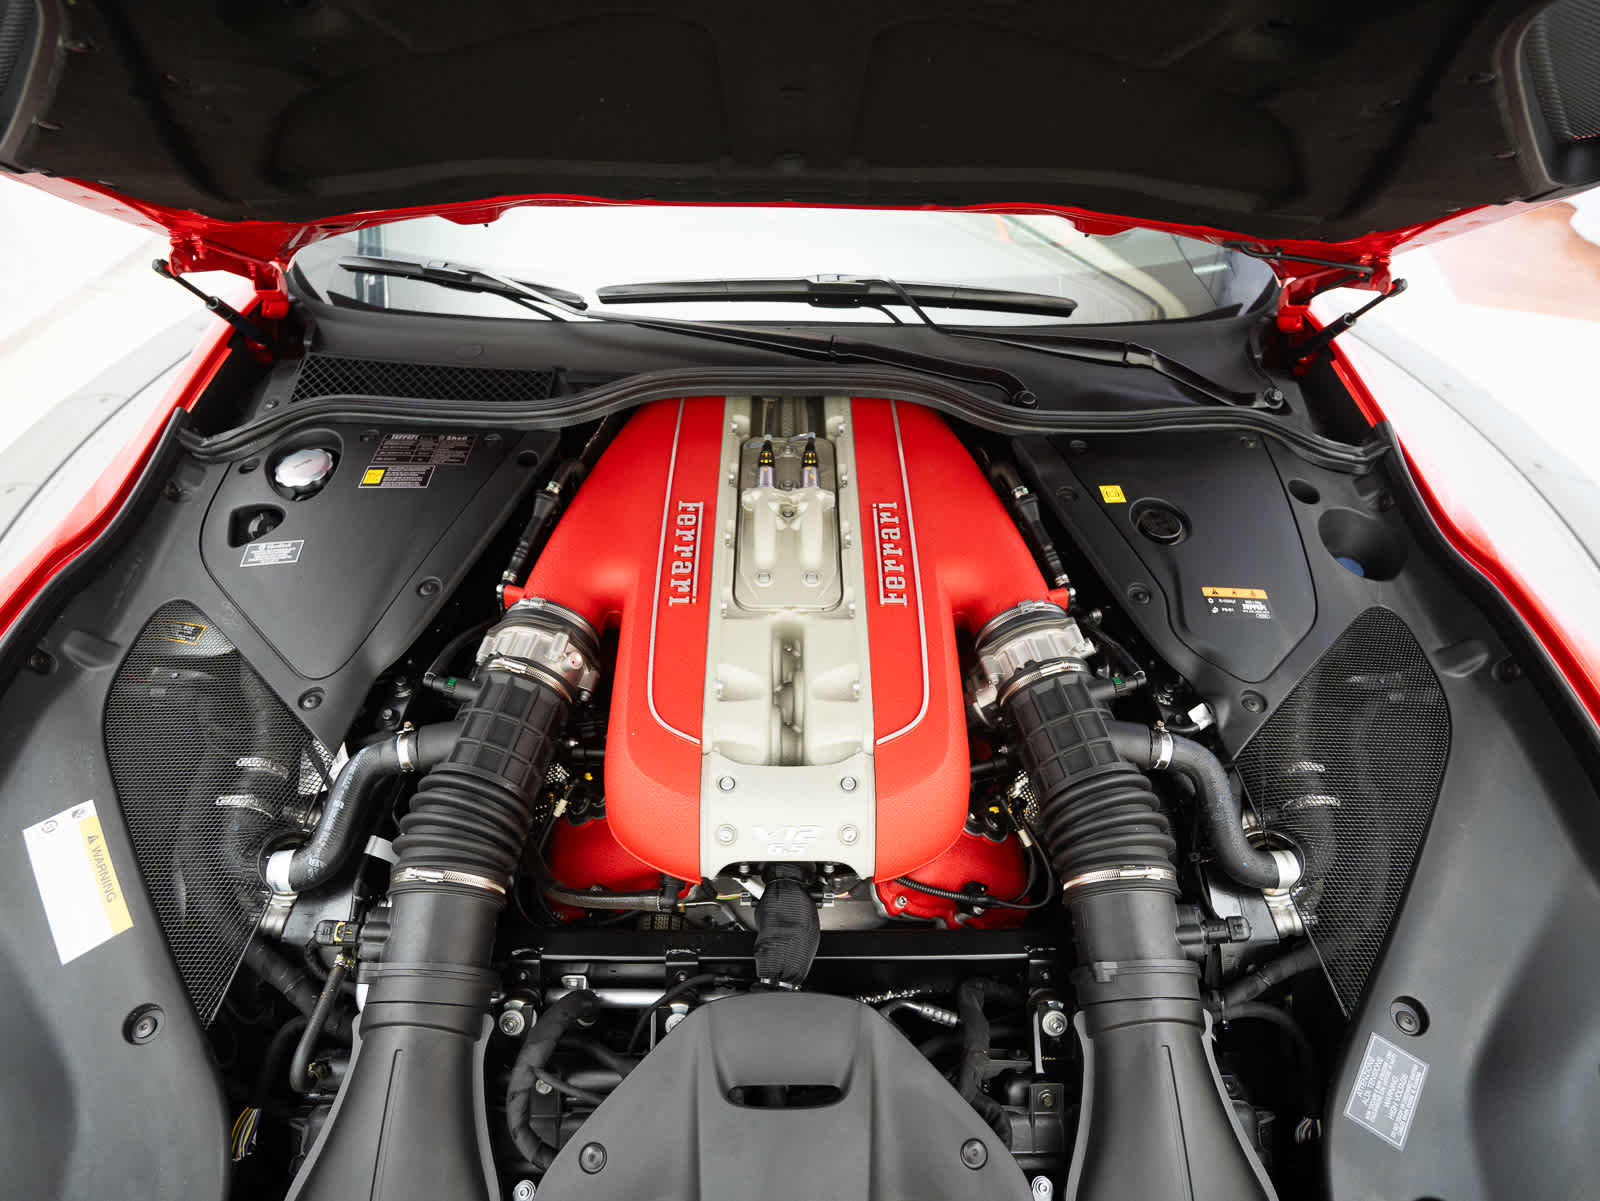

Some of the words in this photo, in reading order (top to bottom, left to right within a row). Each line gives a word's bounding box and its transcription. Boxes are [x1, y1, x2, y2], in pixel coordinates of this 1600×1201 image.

[668, 500, 704, 607] Ferrari
[872, 501, 908, 607] Ferrari
[91, 846, 117, 903] WARNING
